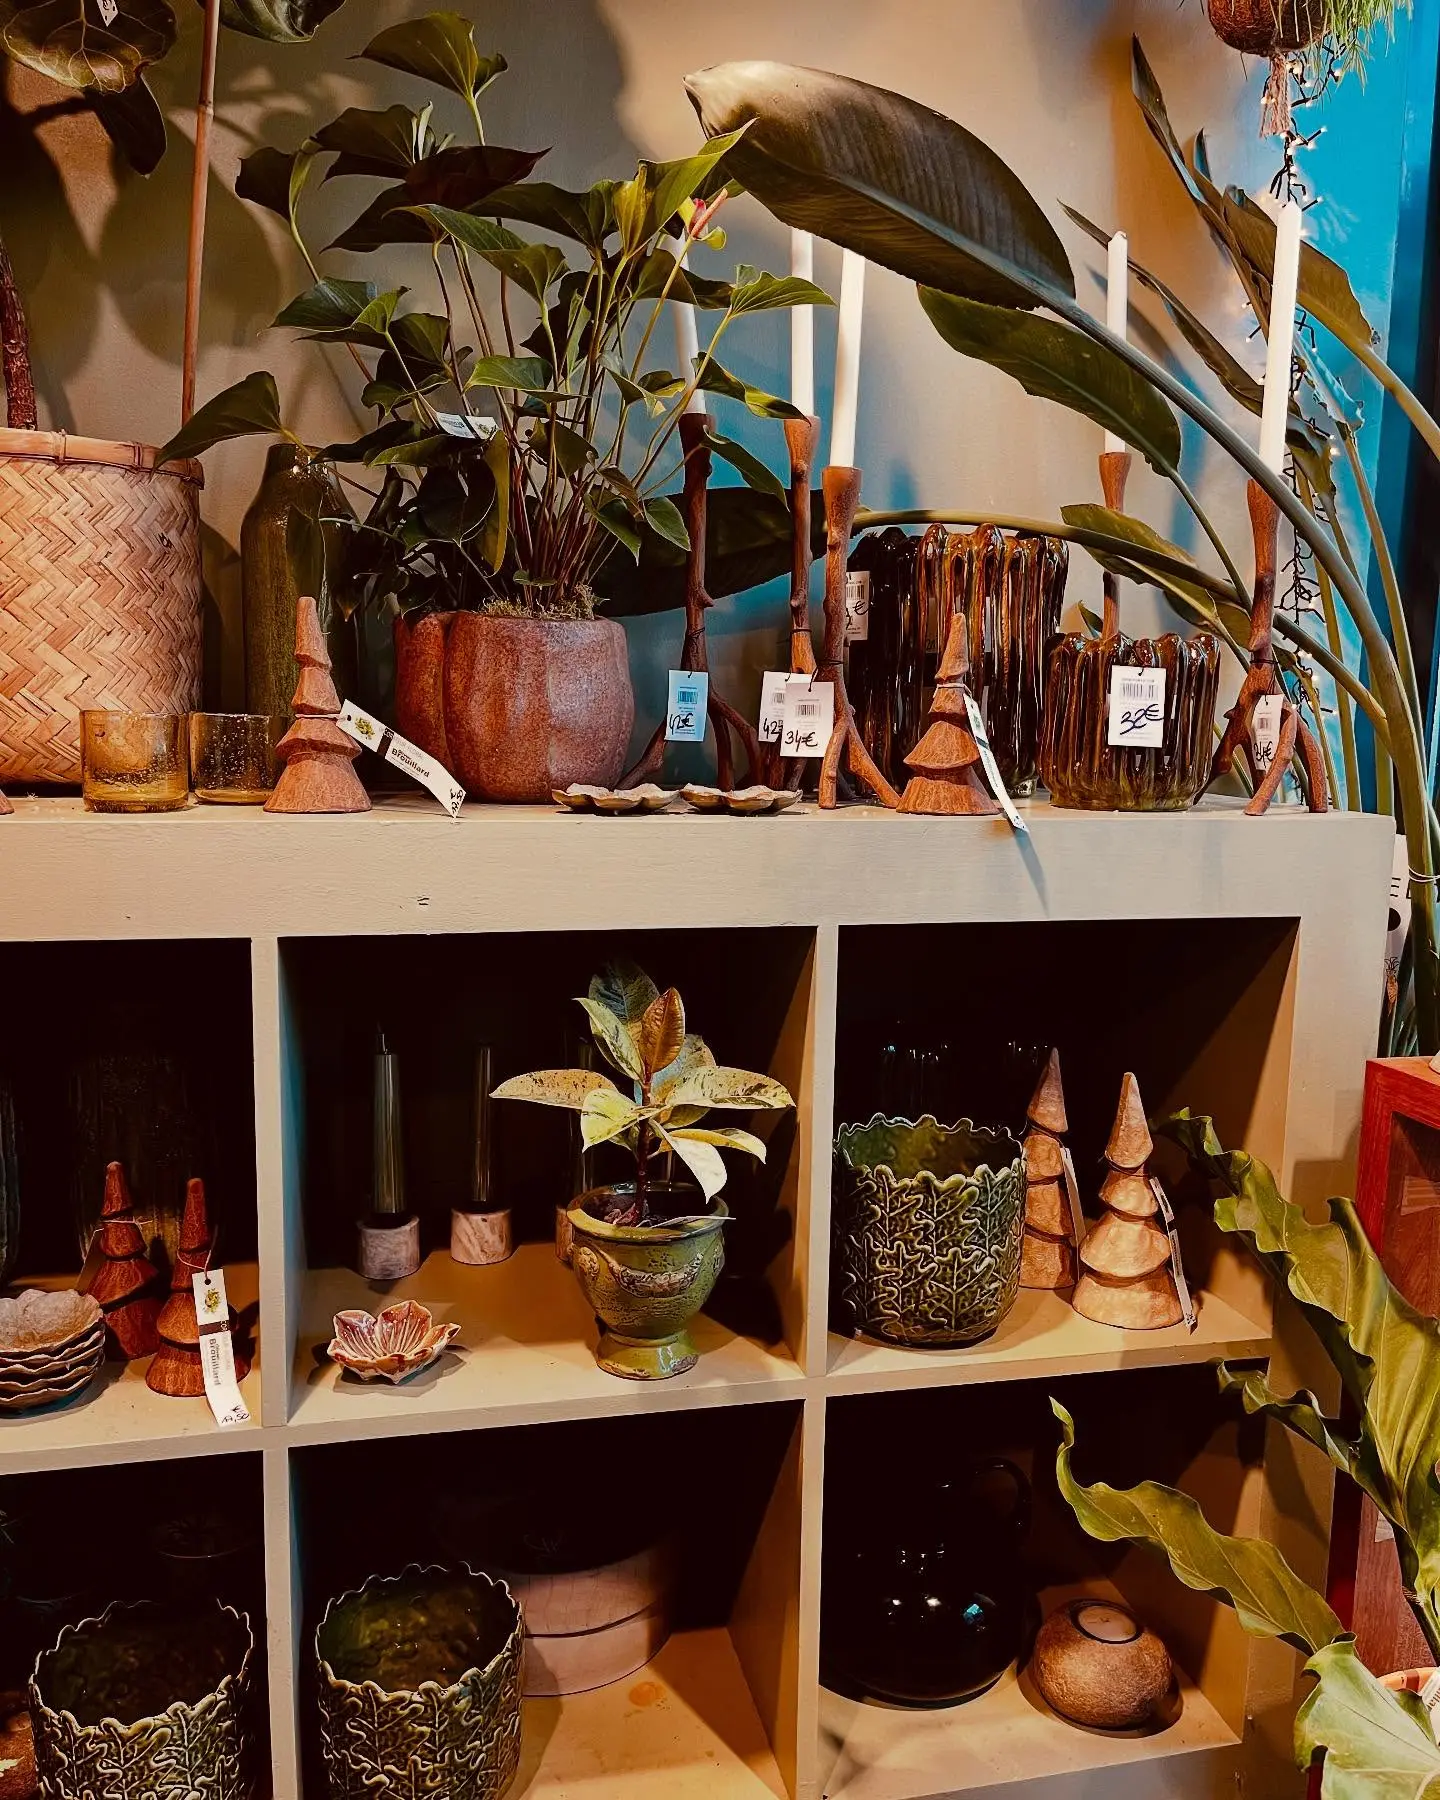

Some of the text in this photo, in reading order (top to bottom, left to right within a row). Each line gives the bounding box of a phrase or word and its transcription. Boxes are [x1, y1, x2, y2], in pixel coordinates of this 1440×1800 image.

[669, 712, 695, 735] 42€
[784, 729, 818, 752] 34€
[391, 747, 430, 778] Brouillard
[209, 1338, 222, 1387] Brouillard
